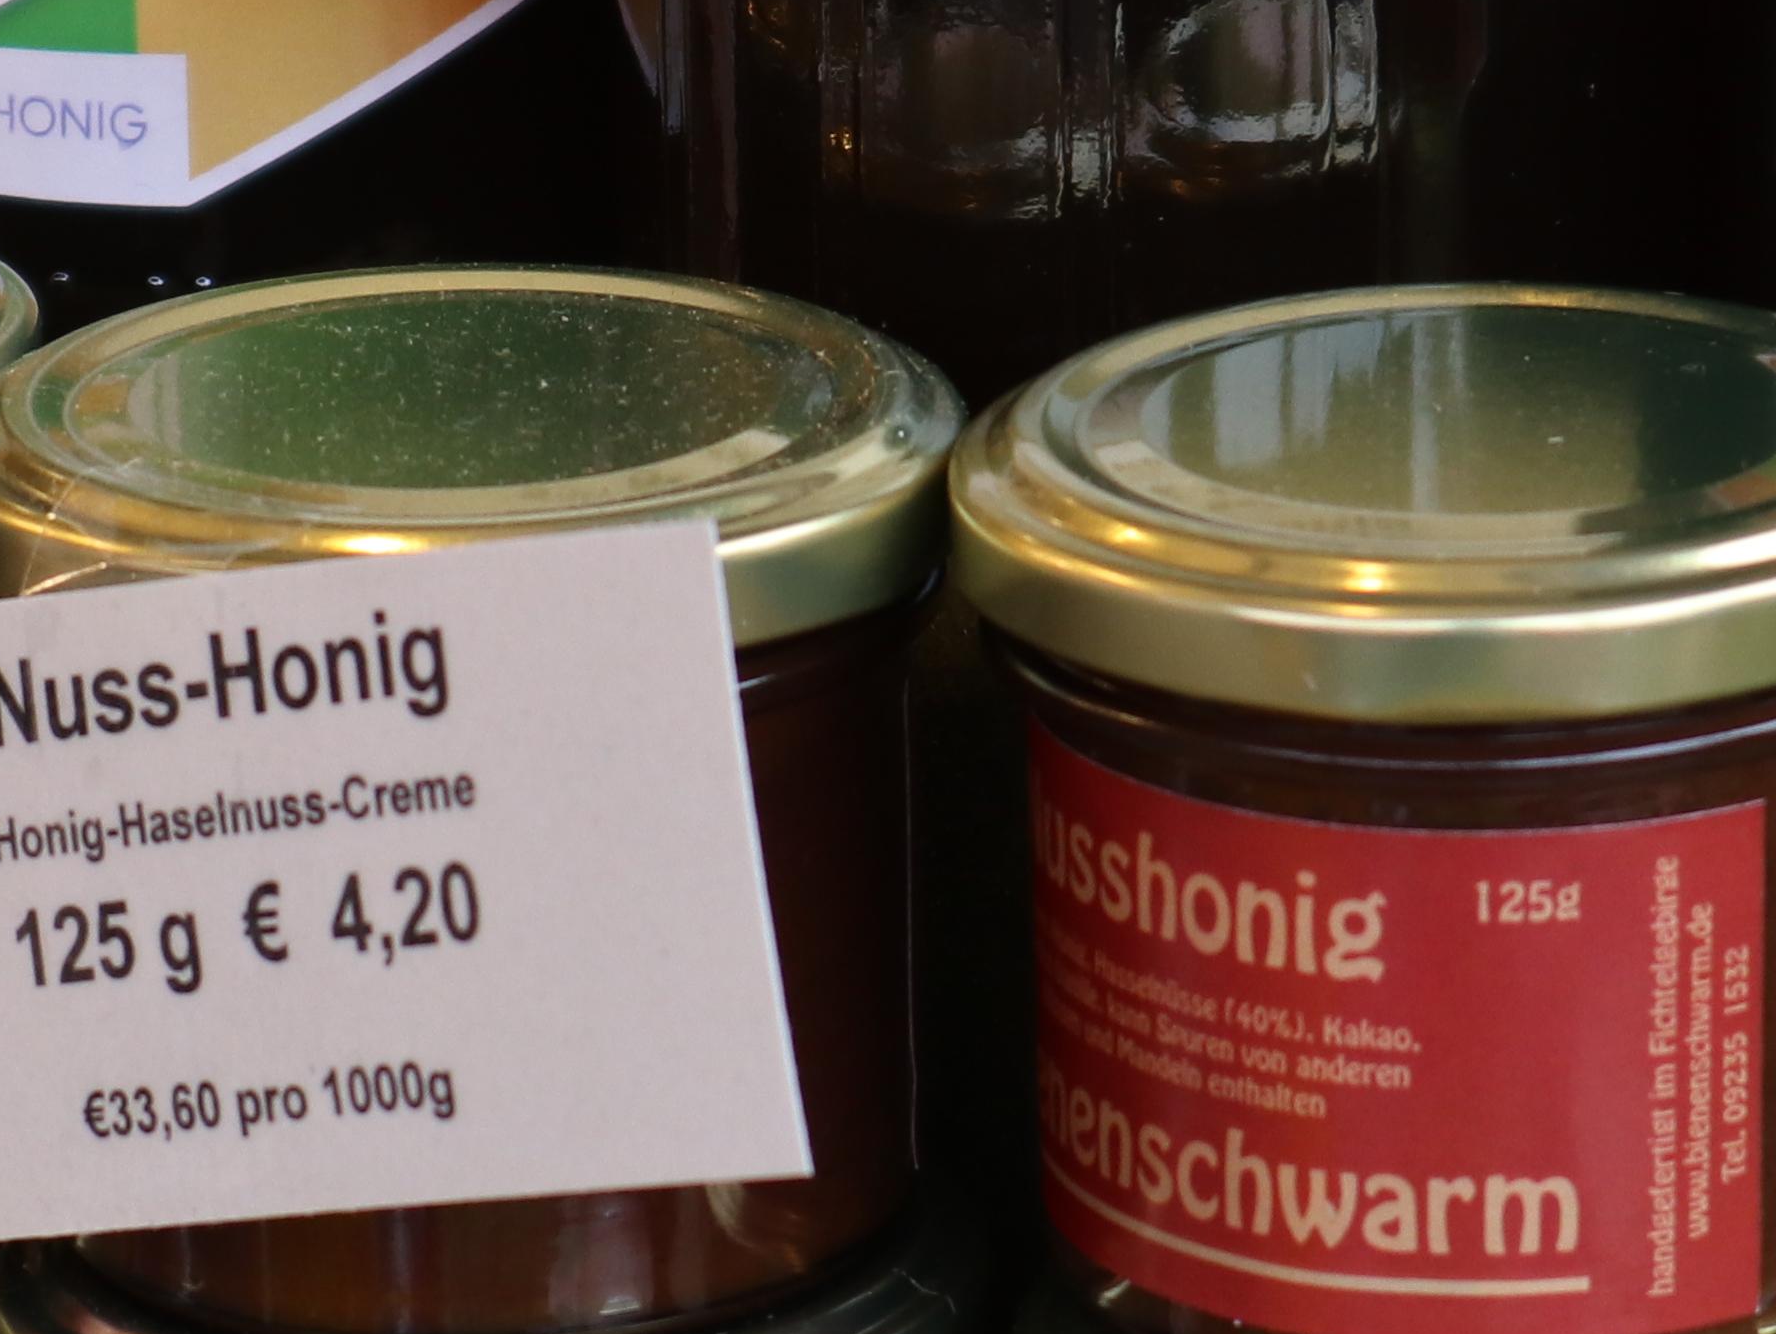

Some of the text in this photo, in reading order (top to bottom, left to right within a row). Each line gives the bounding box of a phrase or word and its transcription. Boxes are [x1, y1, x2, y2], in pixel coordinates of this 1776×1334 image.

[15, 860, 483, 996] 125 g € 4,20
[1034, 797, 1582, 984] usshonig 125g
[82, 1059, 458, 1145] €33,60 pro 1000g
